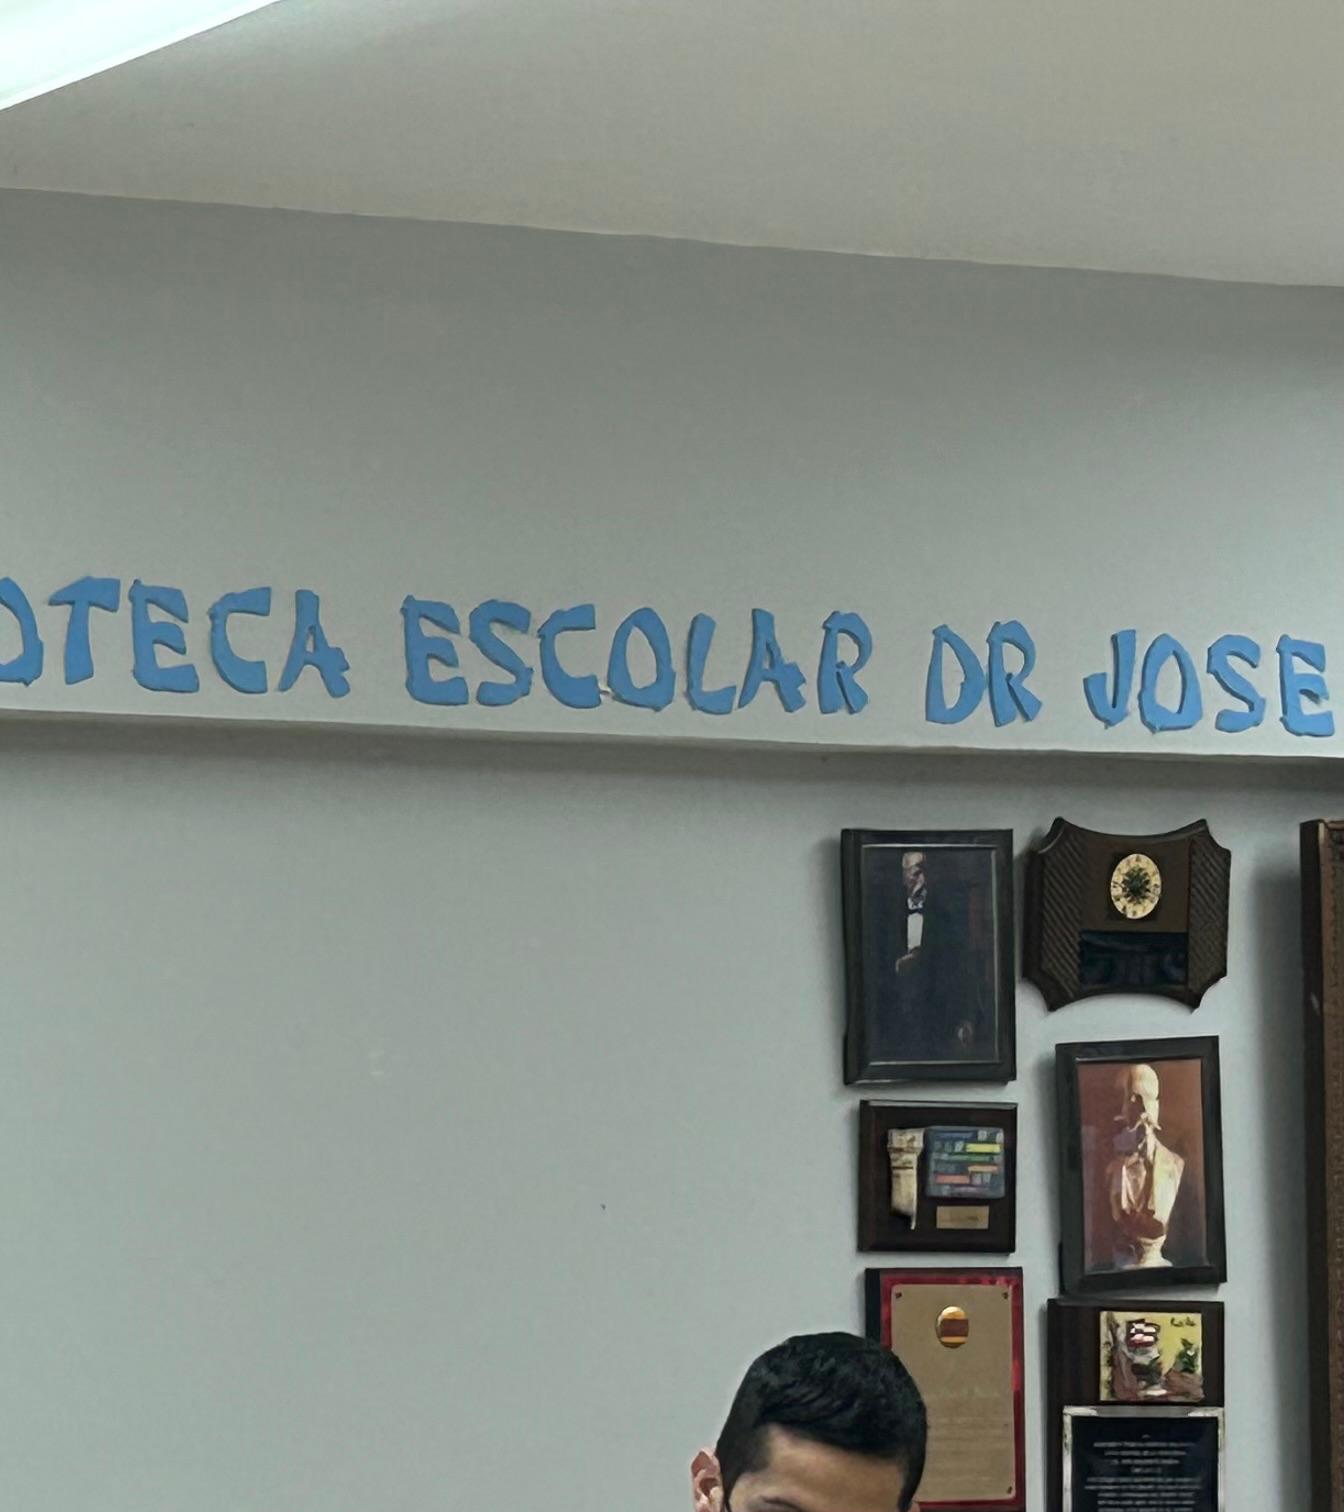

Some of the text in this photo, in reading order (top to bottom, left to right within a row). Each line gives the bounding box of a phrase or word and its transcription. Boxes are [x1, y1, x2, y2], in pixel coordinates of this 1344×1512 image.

[403, 595, 872, 715] ESCOLAR
[926, 621, 1043, 727] DR
[1083, 628, 1336, 737] JOSE
